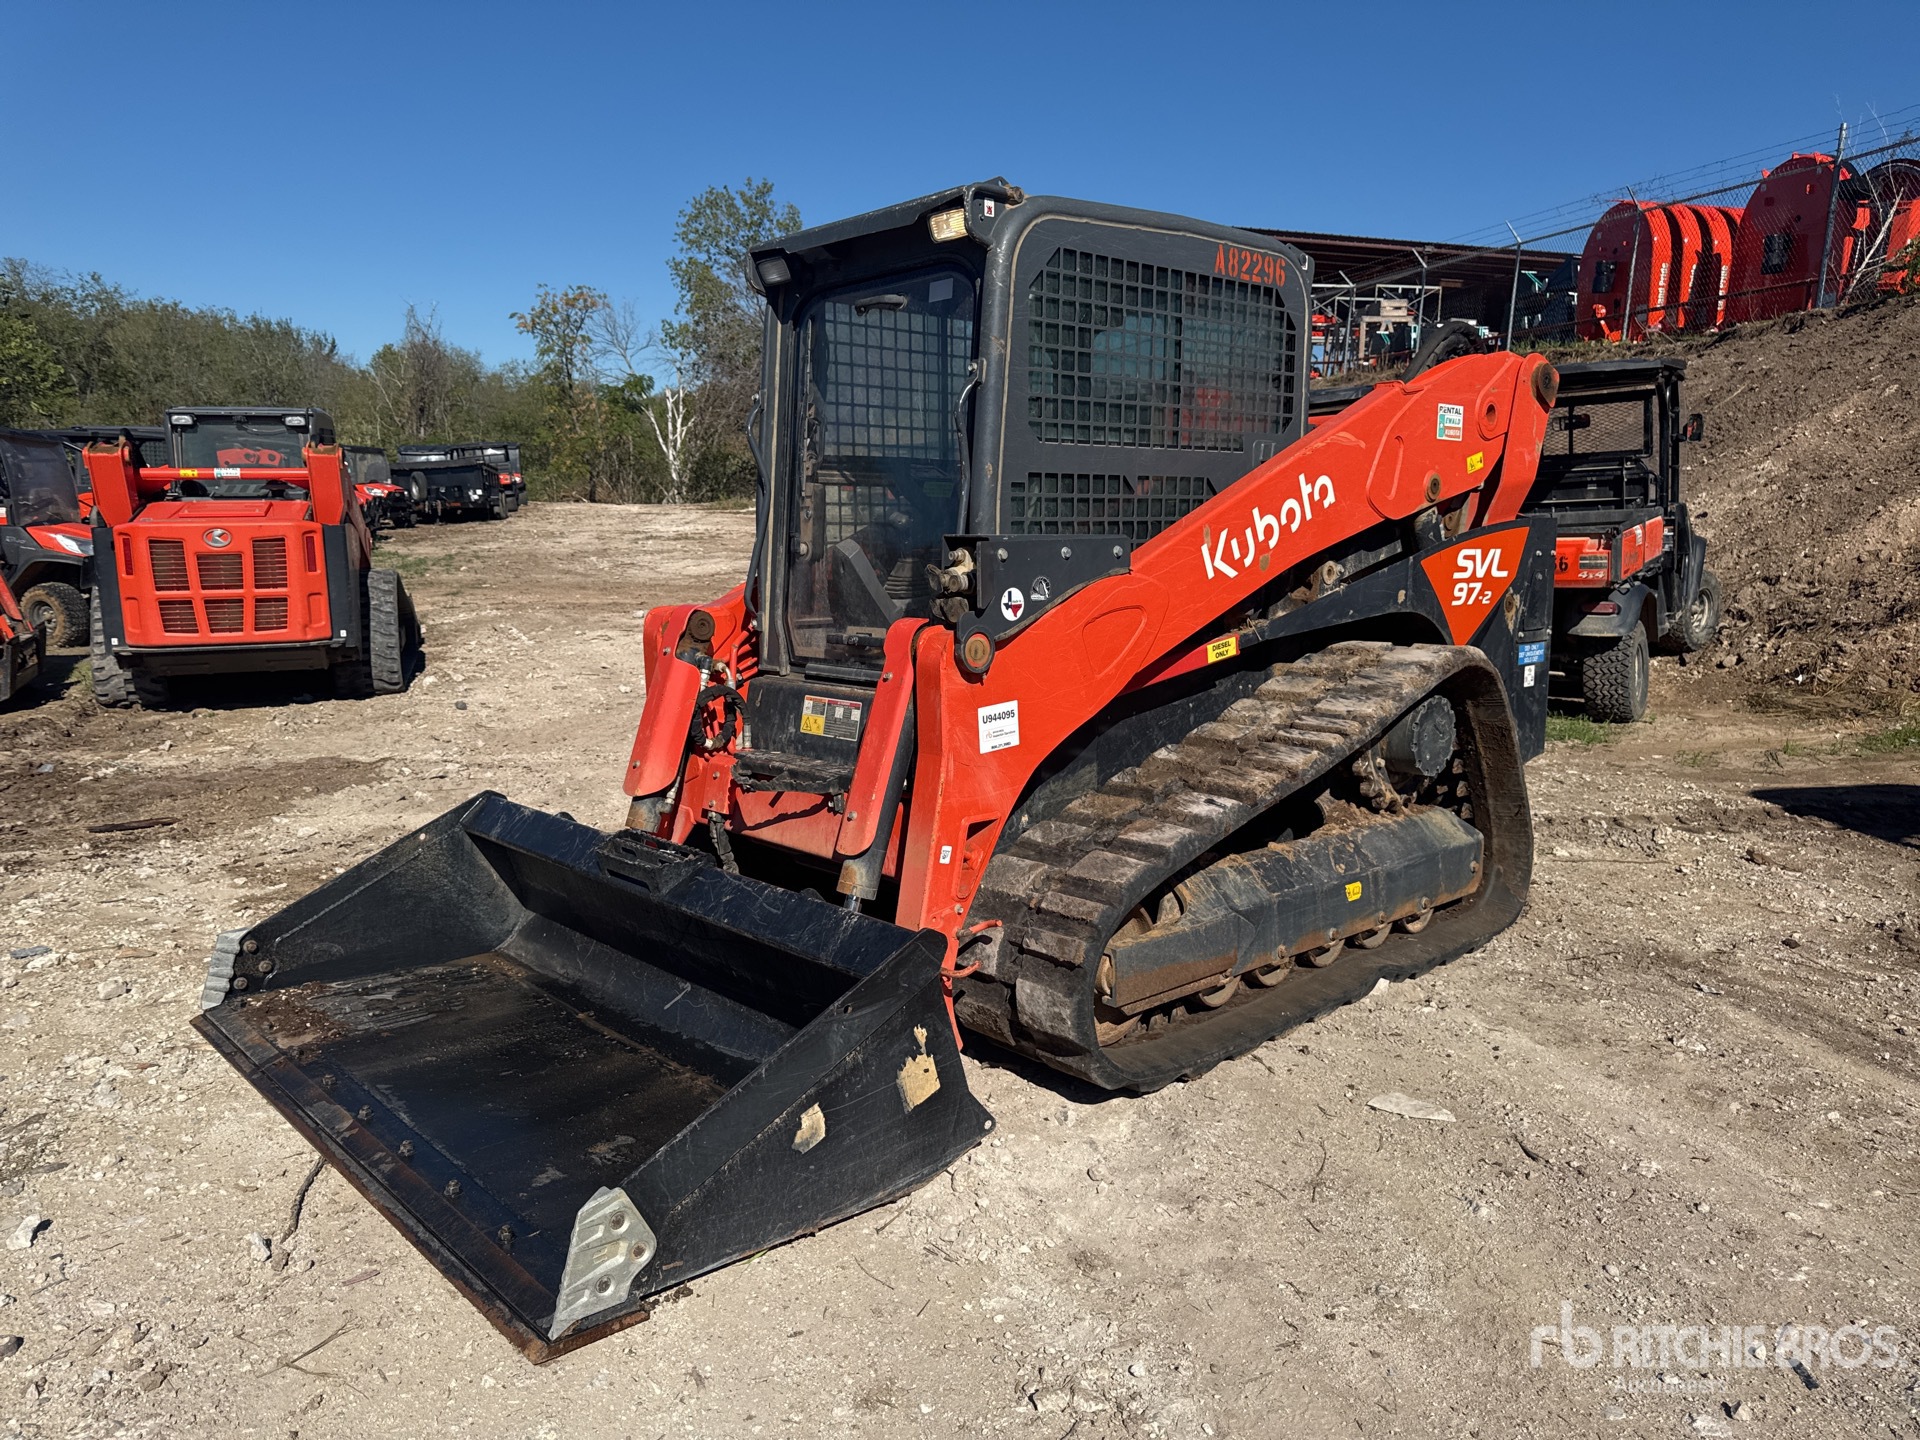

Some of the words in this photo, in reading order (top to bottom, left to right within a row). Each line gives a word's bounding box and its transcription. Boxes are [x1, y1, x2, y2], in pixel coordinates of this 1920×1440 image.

[1214, 243, 1286, 288] A82296
[1439, 406, 1462, 415] RENTAL
[1200, 472, 1336, 580] Kubota
[1452, 548, 1509, 579] SVL
[1451, 582, 1492, 606] 97-2
[1212, 640, 1231, 651] DIESEL
[1215, 649, 1229, 659] ONLY
[982, 709, 1016, 725] U944095
